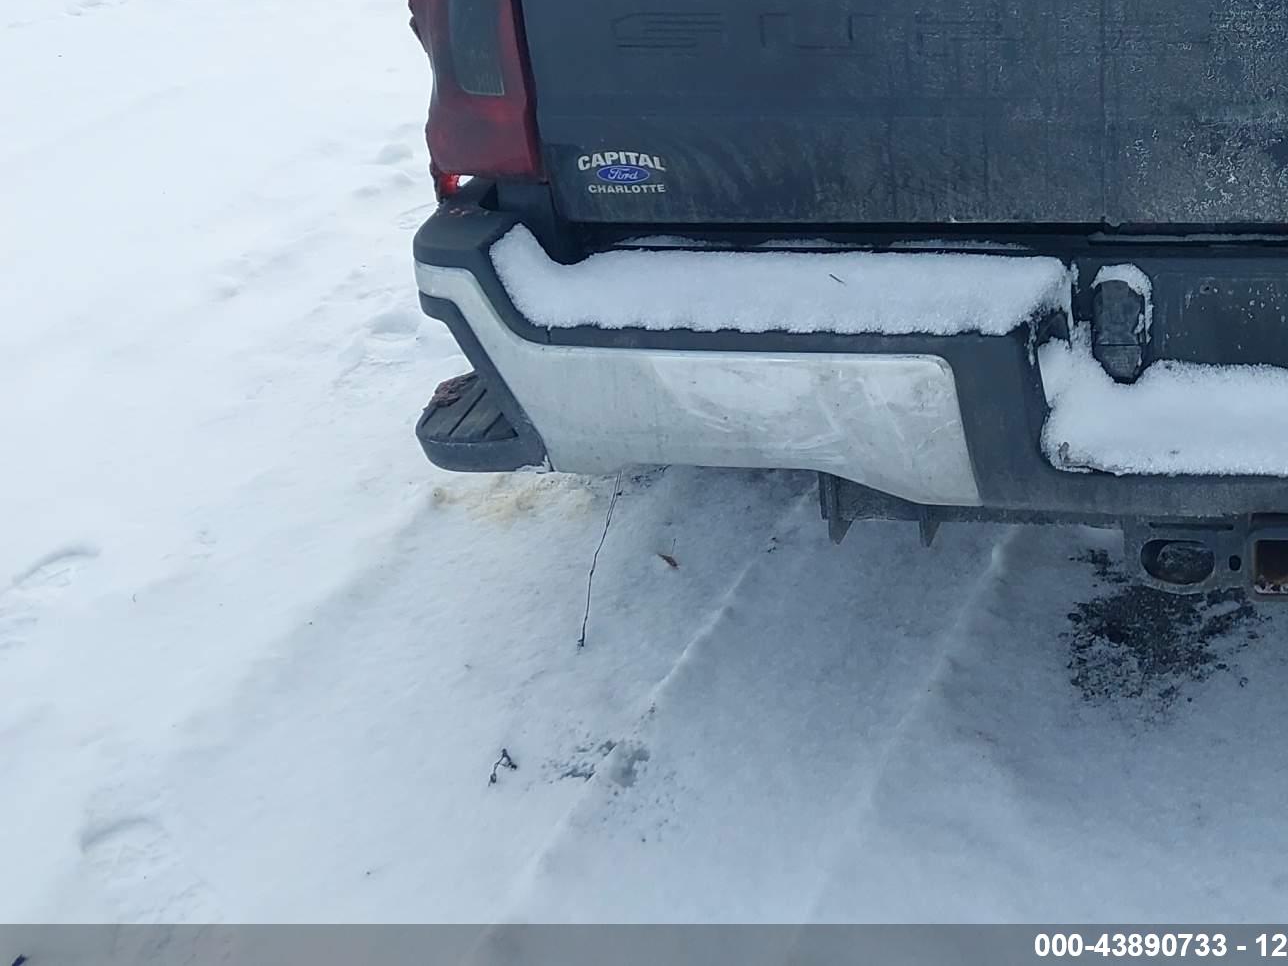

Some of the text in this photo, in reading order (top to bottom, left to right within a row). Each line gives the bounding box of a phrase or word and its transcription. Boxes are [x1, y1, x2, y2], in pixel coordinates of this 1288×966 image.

[578, 151, 666, 171] CAPITAL
[607, 167, 638, 180] Ford
[588, 184, 666, 193] CHARLOTTE
